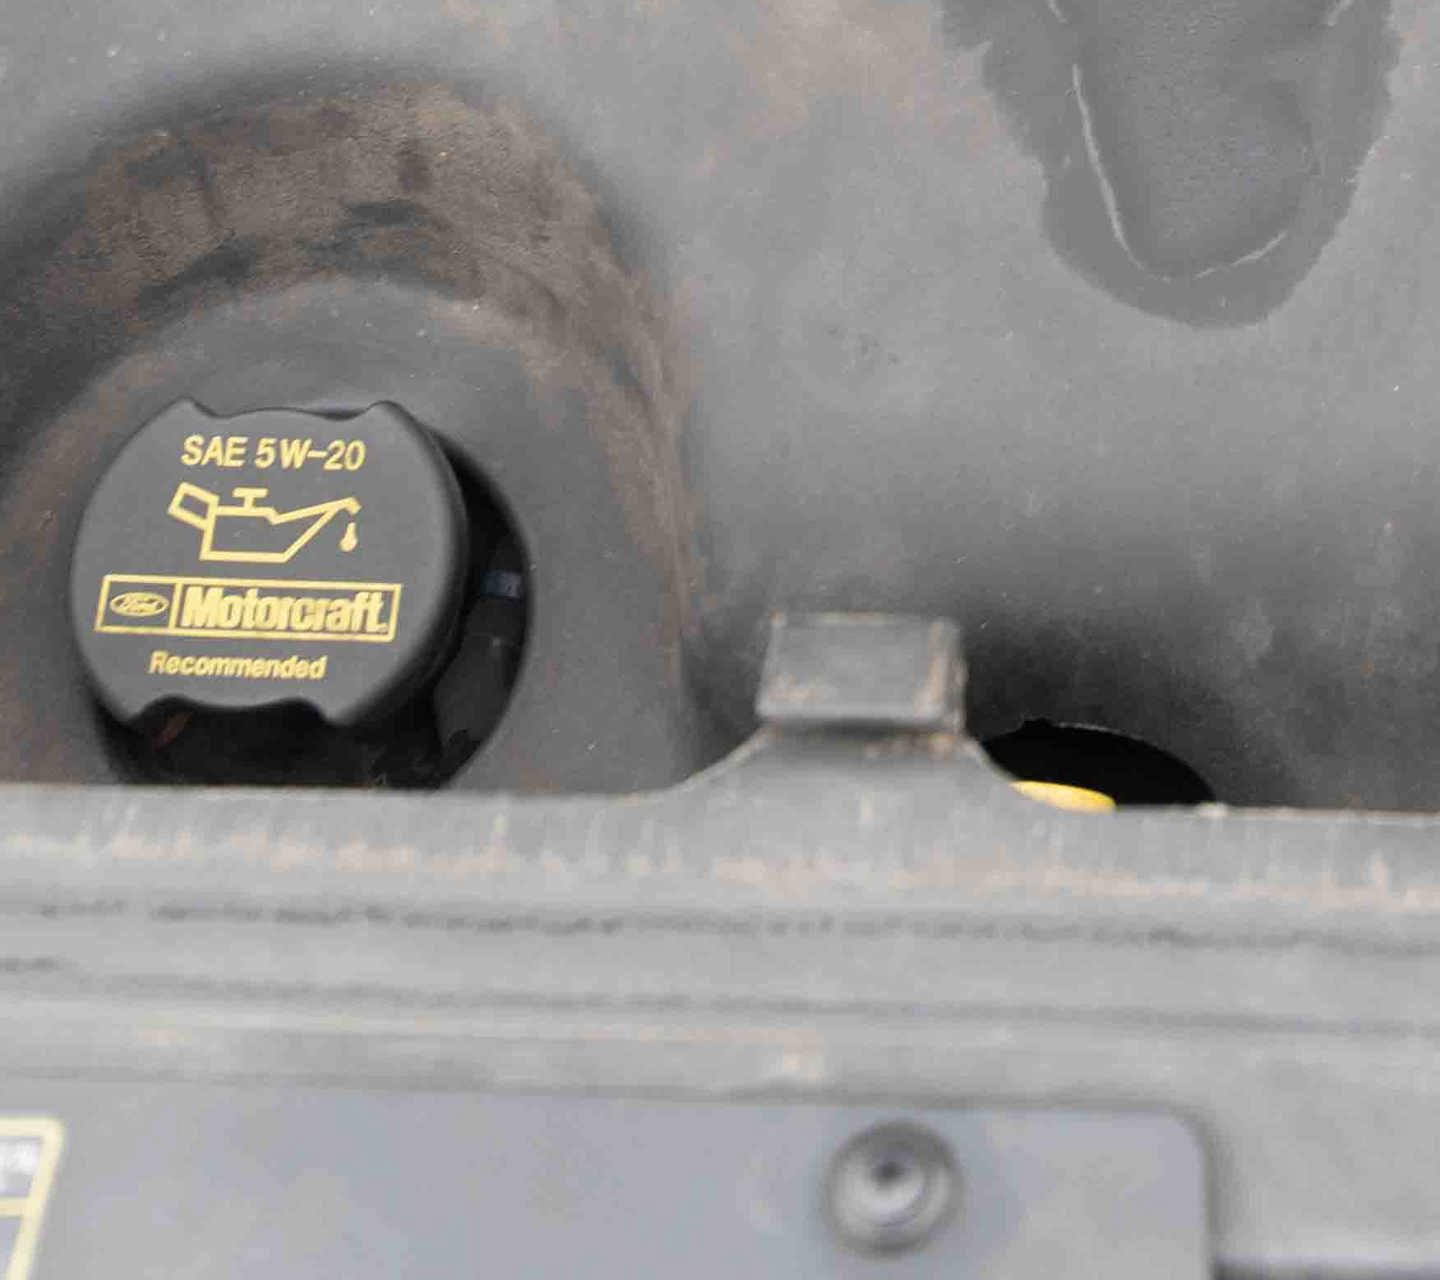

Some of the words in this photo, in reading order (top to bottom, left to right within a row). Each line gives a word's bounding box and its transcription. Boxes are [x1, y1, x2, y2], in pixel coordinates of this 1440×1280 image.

[180, 435, 247, 469] SAE
[256, 437, 367, 471] 5W-20
[115, 592, 165, 616] Ford
[180, 586, 389, 634] Motorcraft
[148, 649, 330, 681] Recommended
